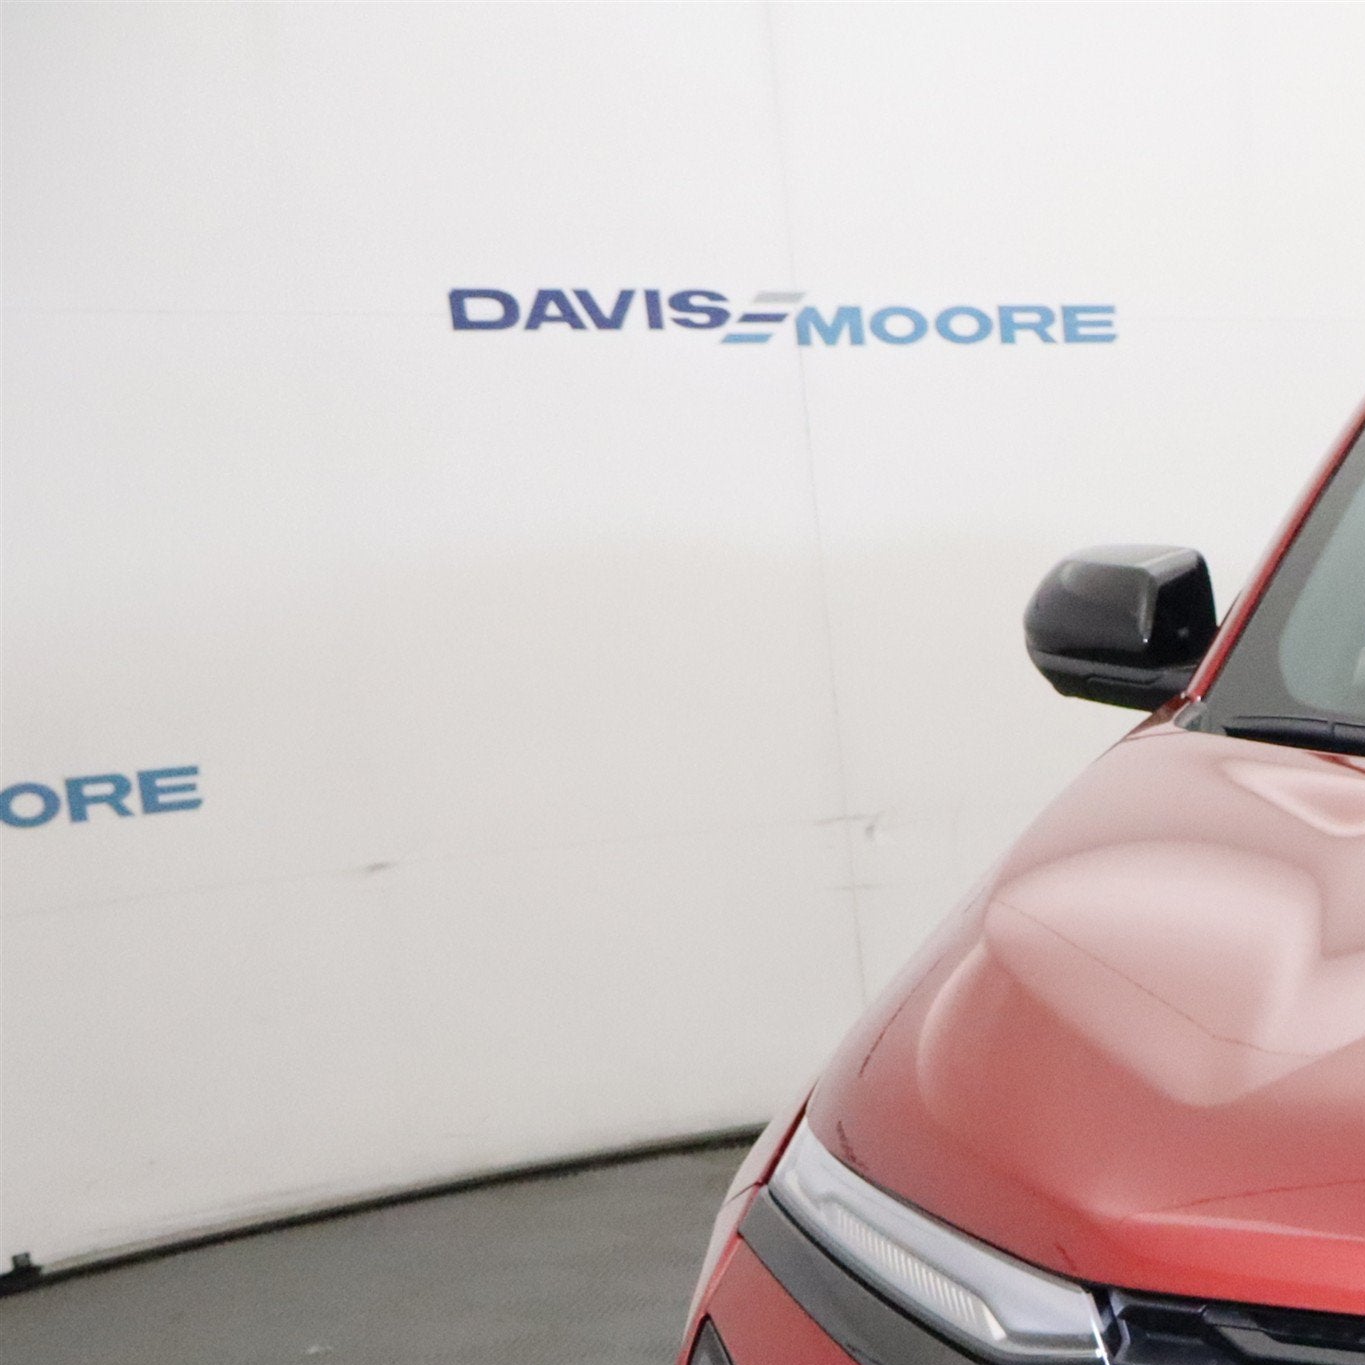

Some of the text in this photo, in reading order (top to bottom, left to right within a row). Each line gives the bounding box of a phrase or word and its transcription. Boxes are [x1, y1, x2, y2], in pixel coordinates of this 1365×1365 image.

[448, 287, 1118, 347] DAVIS MOORE
[0, 766, 203, 828] ORE
